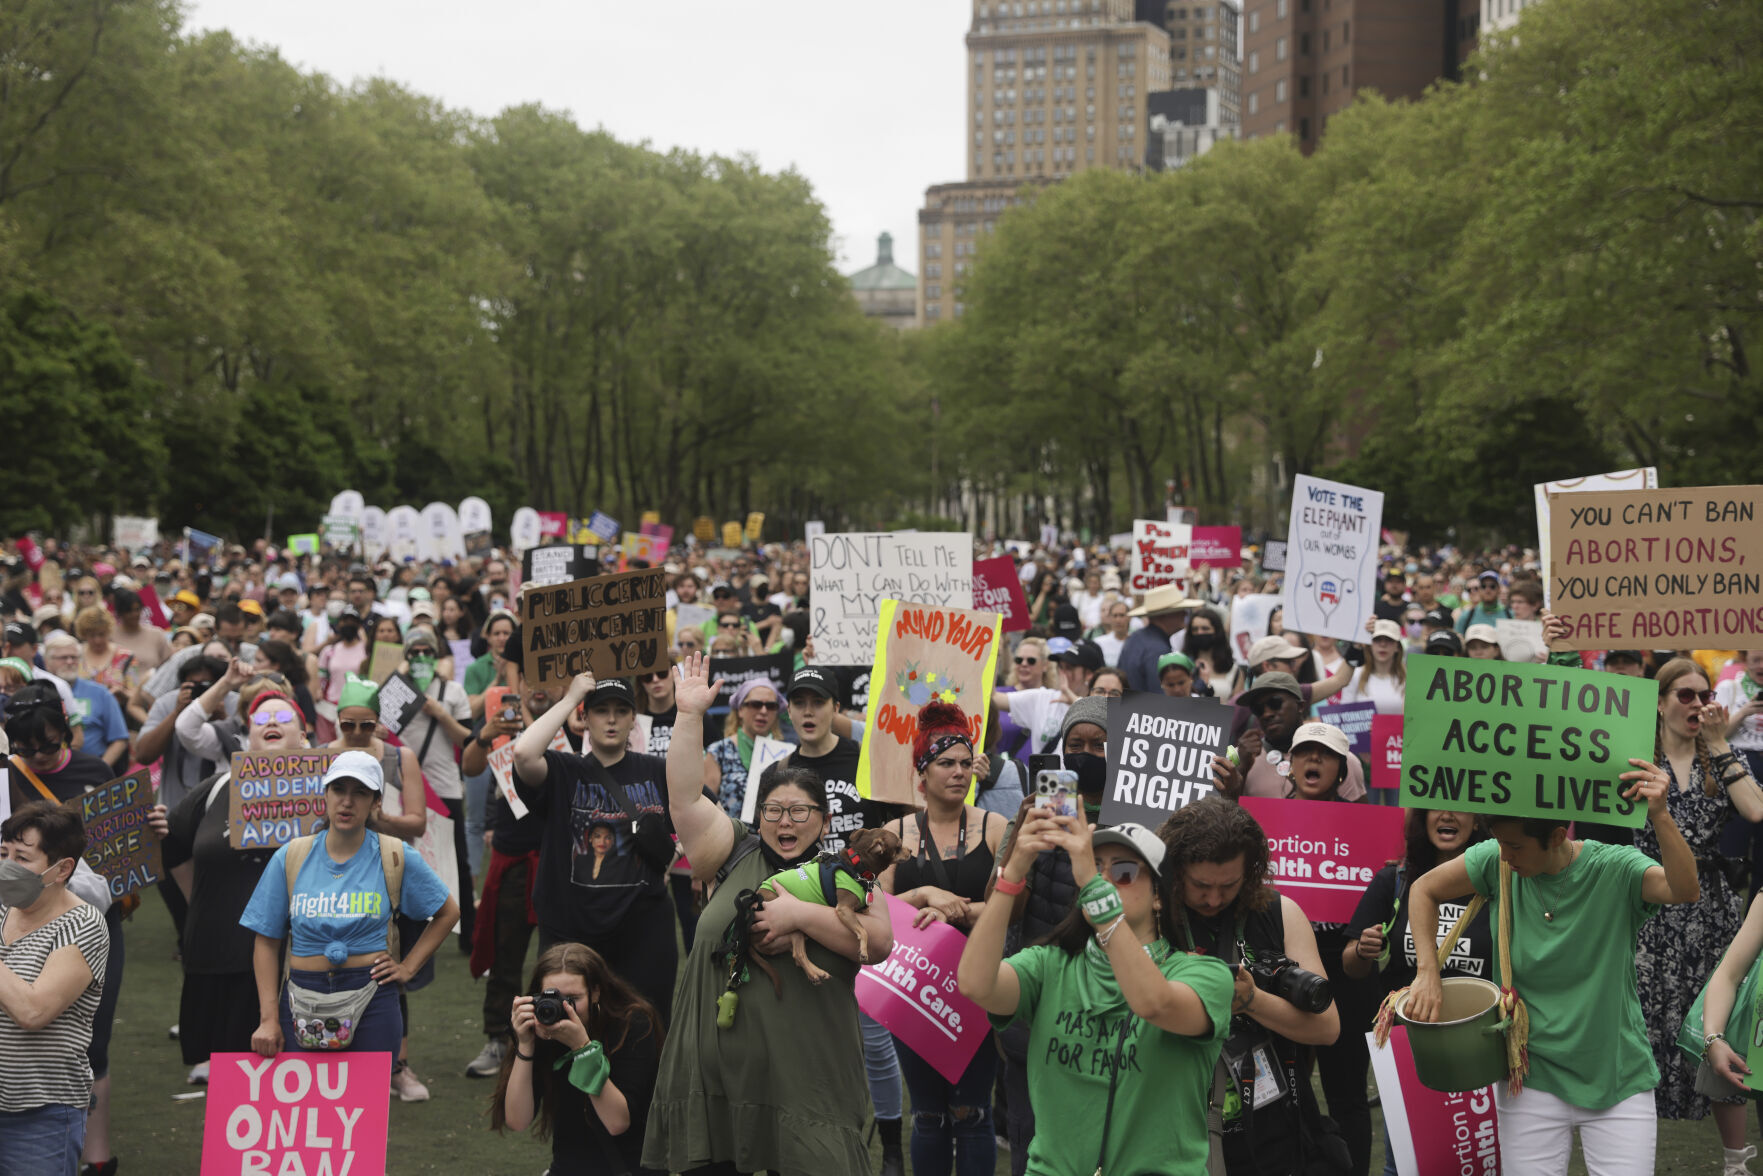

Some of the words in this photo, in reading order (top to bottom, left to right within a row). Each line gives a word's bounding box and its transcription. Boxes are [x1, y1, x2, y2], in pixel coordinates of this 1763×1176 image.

[1308, 486, 1336, 505] VOTE
[1341, 494, 1363, 512] THE
[1570, 507, 1611, 529] YOU
[1623, 501, 1693, 524] CAN'T
[1705, 500, 1754, 522] BAN
[1303, 506, 1367, 534] ELEPHANT
[812, 535, 894, 570] DONT
[895, 545, 928, 567] TELL
[934, 545, 957, 567] ME
[1137, 539, 1188, 559] WOMEN
[1142, 555, 1174, 574] PRO
[1303, 538, 1320, 552] OUR
[1323, 543, 1357, 560] WOMBS
[1566, 536, 1745, 565] ABORTIONS,
[813, 575, 845, 592] WHAT
[856, 572, 863, 592] I
[872, 573, 902, 592] CAN
[934, 572, 971, 592] WITH
[1557, 576, 1599, 601] YOU
[1605, 574, 1648, 597] CAN
[1655, 573, 1709, 595] ONLY
[1713, 572, 1760, 595] BAN
[841, 592, 880, 616] MY
[530, 606, 666, 652] ANNOUNCEMENT
[813, 607, 830, 639] &
[836, 621, 844, 635] I
[896, 609, 945, 643] MIND
[945, 612, 994, 661] YOUR
[1557, 612, 1622, 640] SAFE
[537, 648, 595, 682] FUCK
[609, 638, 657, 672] YOU
[1426, 667, 1631, 719] ABORTION
[1125, 712, 1222, 747] ABORTION
[1442, 718, 1611, 764] ACCESS
[1119, 736, 1150, 769] IS
[1156, 743, 1217, 780] OUR
[82, 778, 139, 823] KEEP
[240, 777, 272, 801] ON
[1112, 768, 1214, 812] RIGHT
[1408, 764, 1512, 804] SAVES
[1535, 773, 1635, 816] LIVES
[241, 798, 327, 822] WITHOU
[85, 829, 142, 868] SAFE
[1334, 837, 1350, 857] is
[101, 856, 132, 876] AND
[110, 864, 157, 897] GAL
[1318, 860, 1374, 883] Care
[941, 971, 958, 993] is
[919, 984, 963, 1033] Care.
[1055, 1009, 1097, 1039] MÁS
[1045, 1036, 1083, 1073] POR
[235, 1058, 349, 1104] YOU
[1288, 1067, 1299, 1107] SONY
[225, 1104, 365, 1151] ONLY
